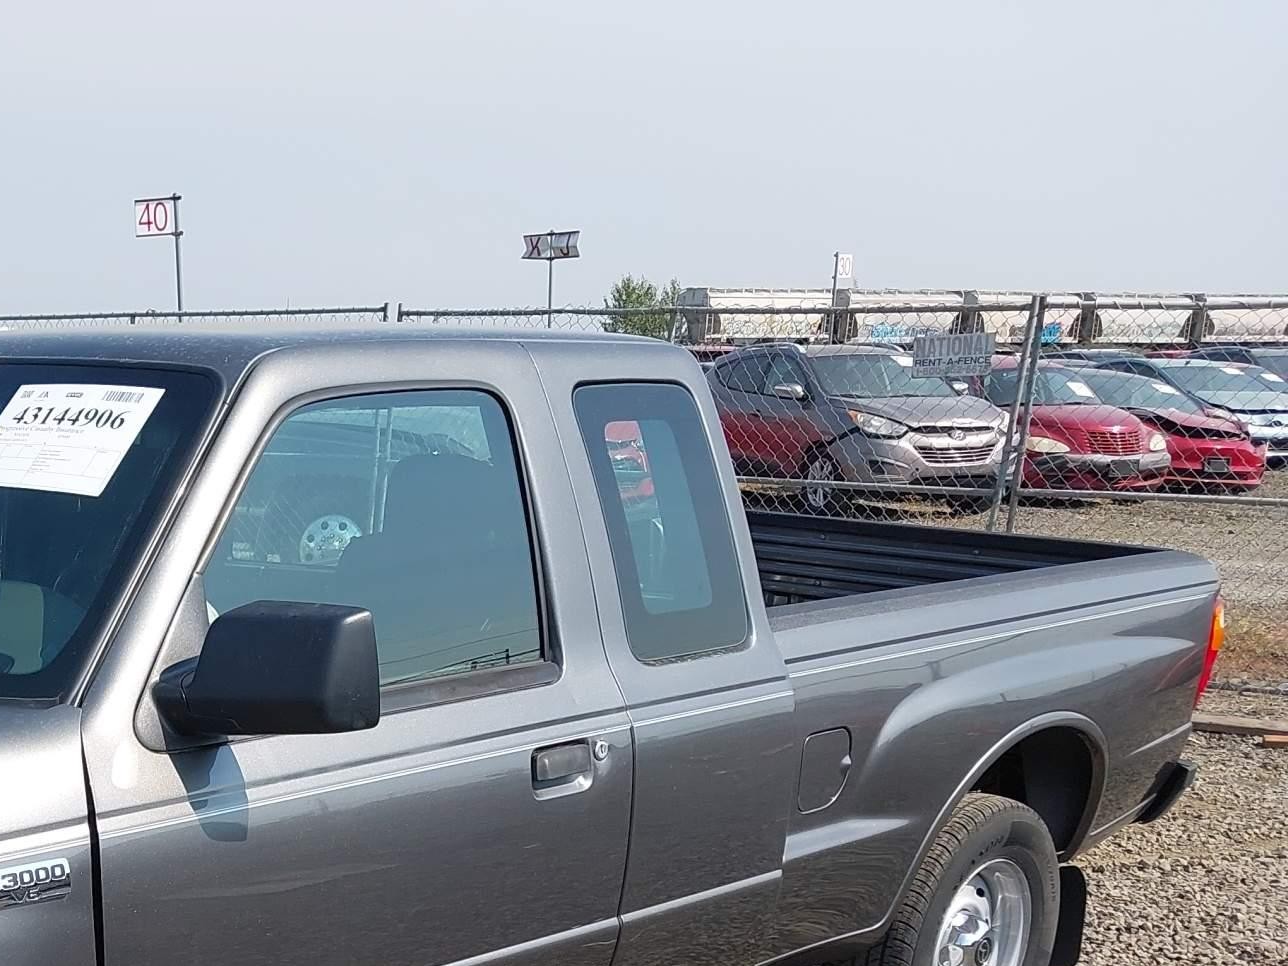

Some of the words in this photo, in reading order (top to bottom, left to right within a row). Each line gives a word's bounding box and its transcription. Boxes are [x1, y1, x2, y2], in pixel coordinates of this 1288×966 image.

[138, 201, 168, 232] 40
[838, 256, 851, 277] 30
[915, 334, 992, 358] NATIONAL
[914, 355, 992, 368] RENT-A-FENCE
[12, 405, 132, 430] 43144906
[10, 886, 42, 904] V6
